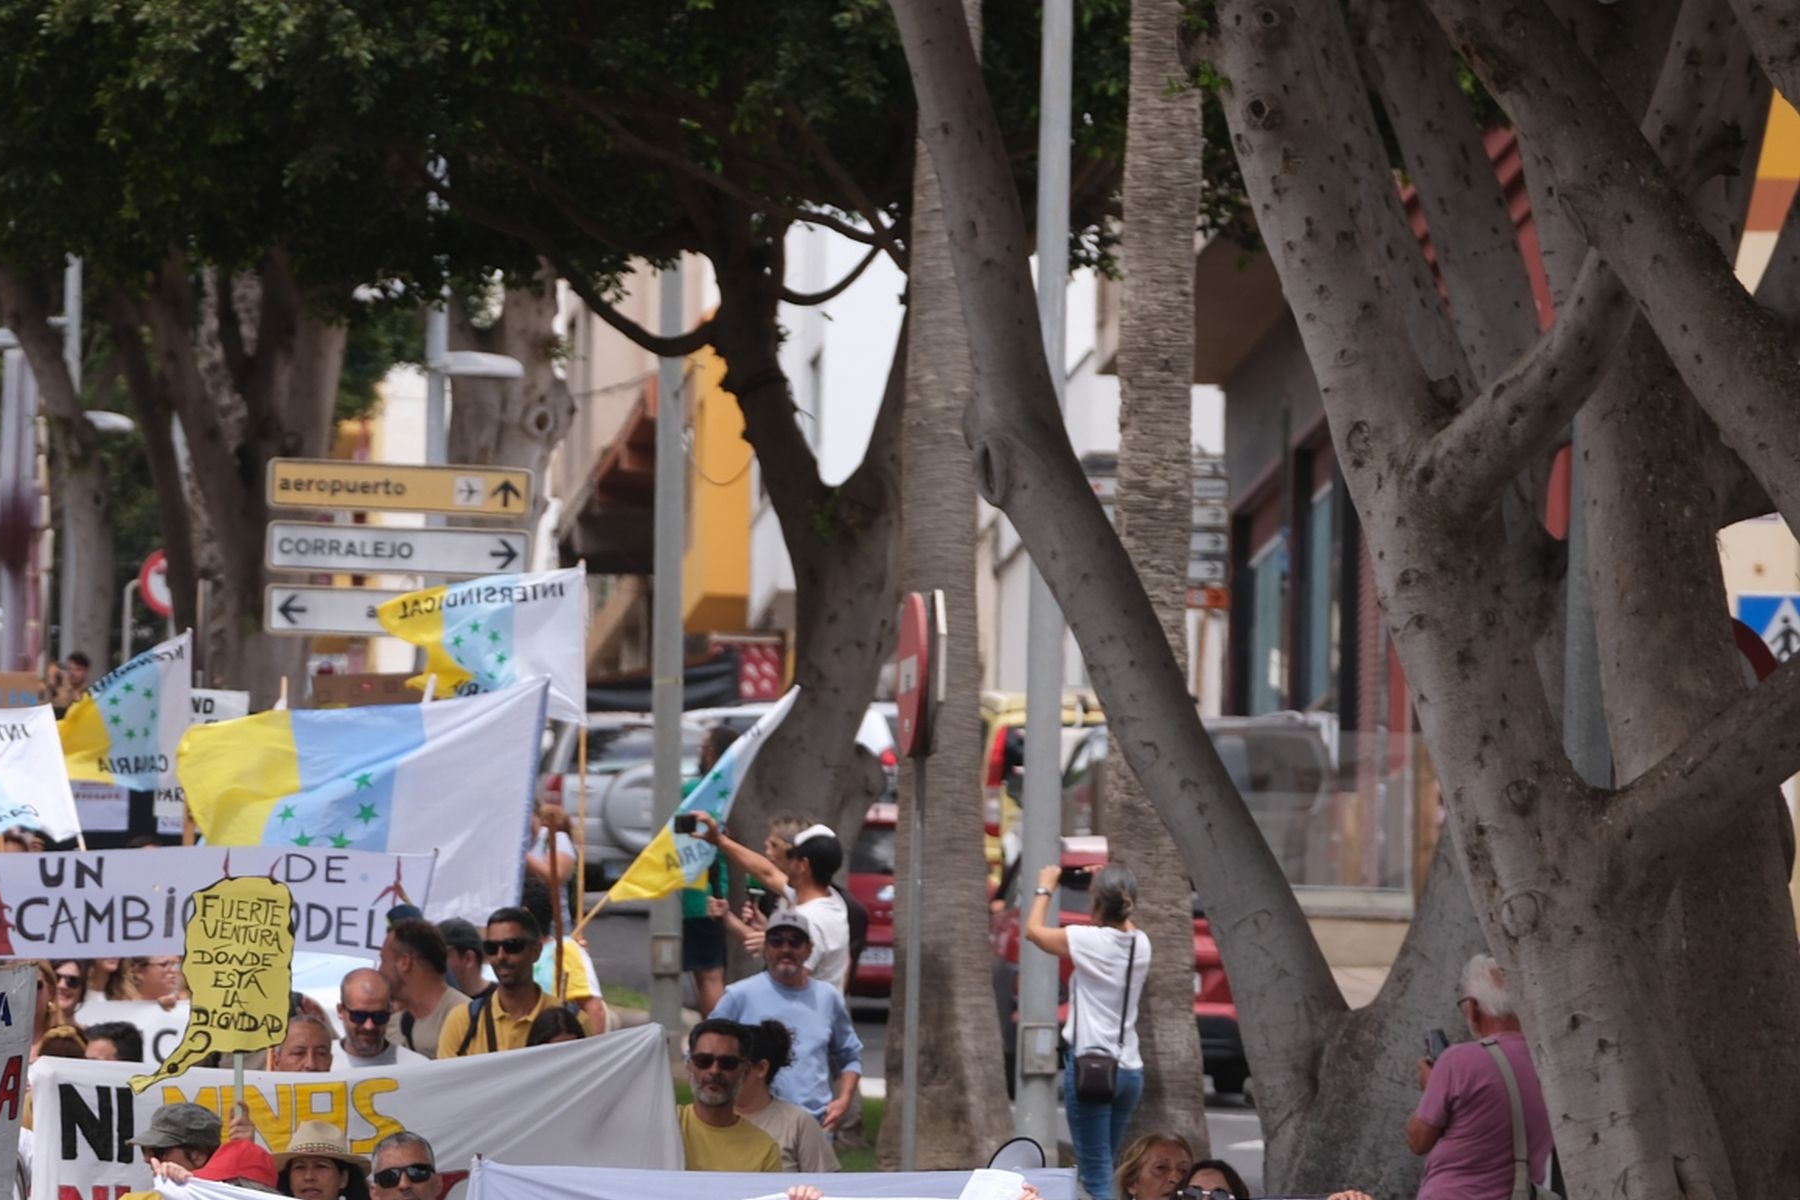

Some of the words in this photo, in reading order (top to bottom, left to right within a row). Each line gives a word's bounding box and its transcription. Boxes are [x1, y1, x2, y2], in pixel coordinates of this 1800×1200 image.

[278, 475, 407, 496] aeropuerto
[278, 537, 414, 560] CORRALEJO
[39, 857, 105, 889] UN
[284, 853, 348, 885] DE
[202, 895, 285, 927] FUERTE
[200, 918, 285, 954] VENTURA
[222, 989, 249, 1010] LA
[191, 1007, 284, 1041] DIGNIDAD
[58, 1083, 135, 1164] NI
